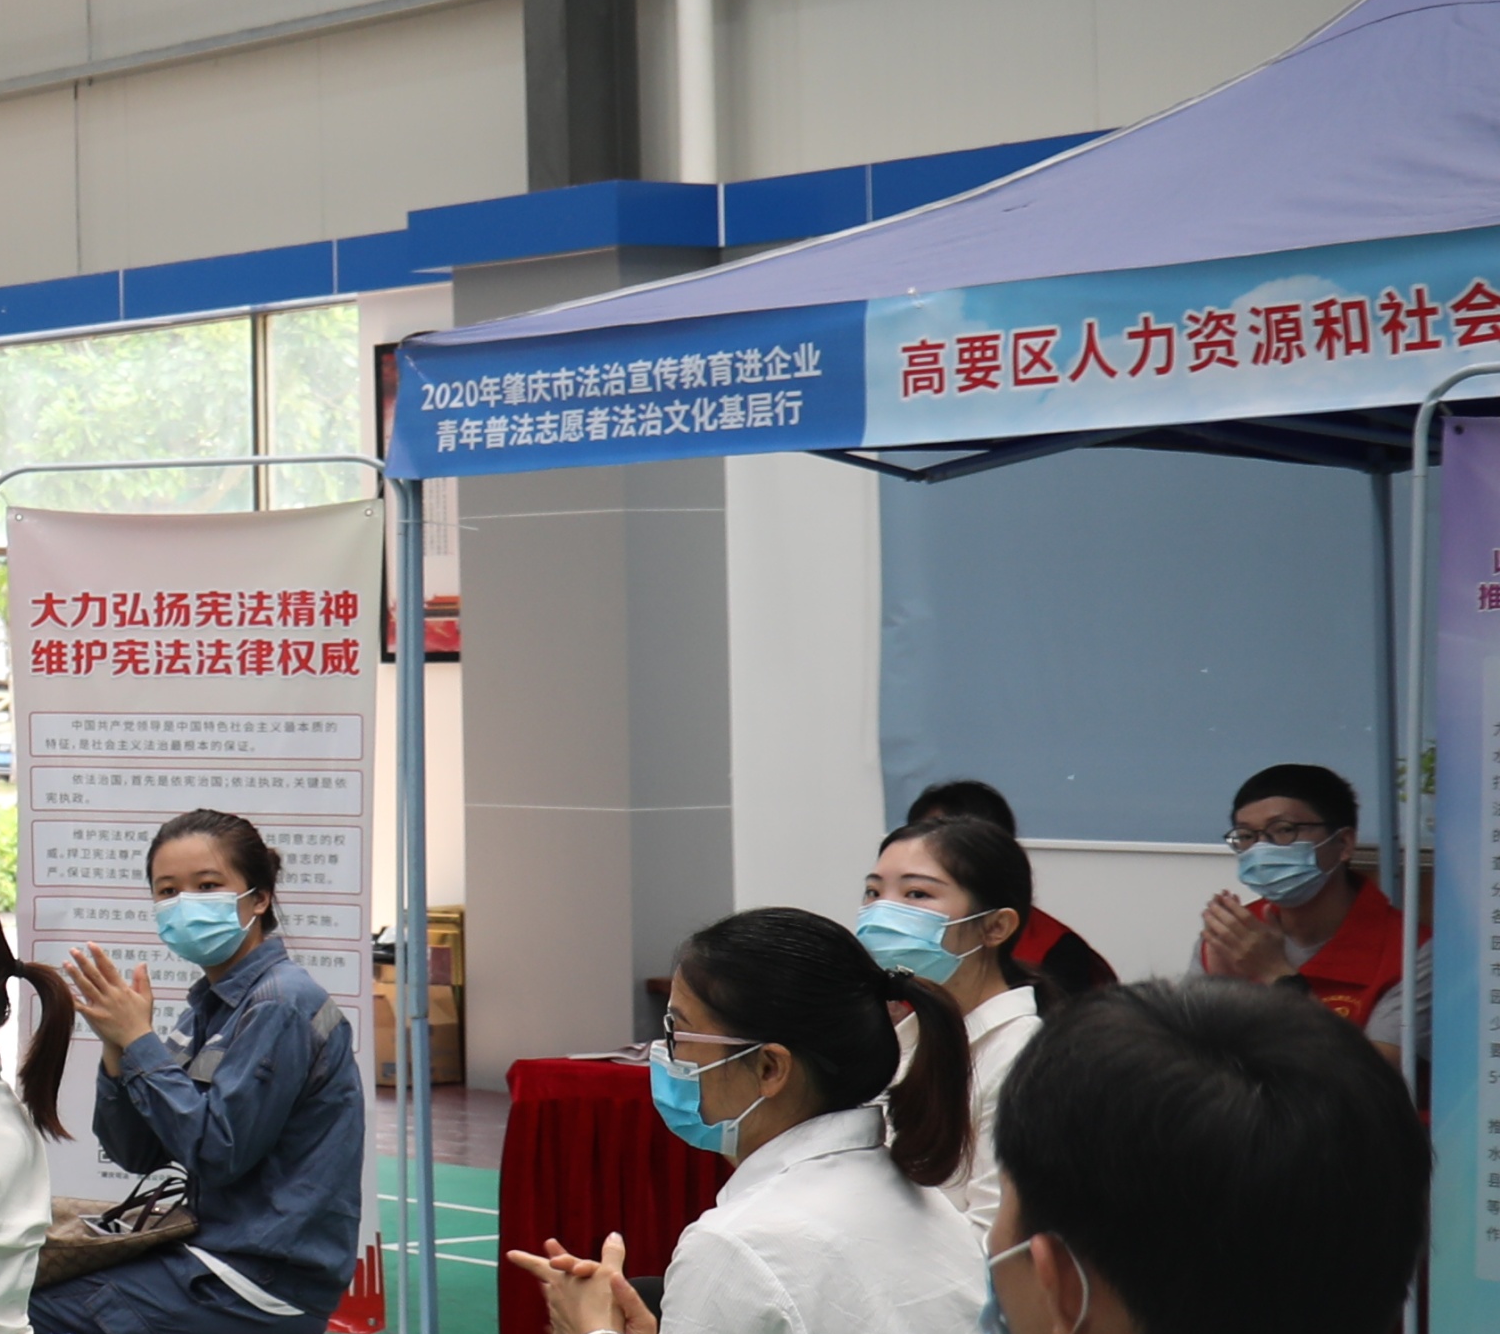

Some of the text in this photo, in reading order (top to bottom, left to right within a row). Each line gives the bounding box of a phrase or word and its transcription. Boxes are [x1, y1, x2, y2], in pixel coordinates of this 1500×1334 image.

[901, 281, 1500, 398] 高要区人力资源和社会
[421, 342, 822, 411] 2020年肇庆市法治宣传教育进企业
[436, 390, 803, 453] 青年普法志愿者法治文化基层行
[30, 589, 360, 630] 大力弘扬宪法精神
[30, 637, 361, 677] 维护宪法法律权威
